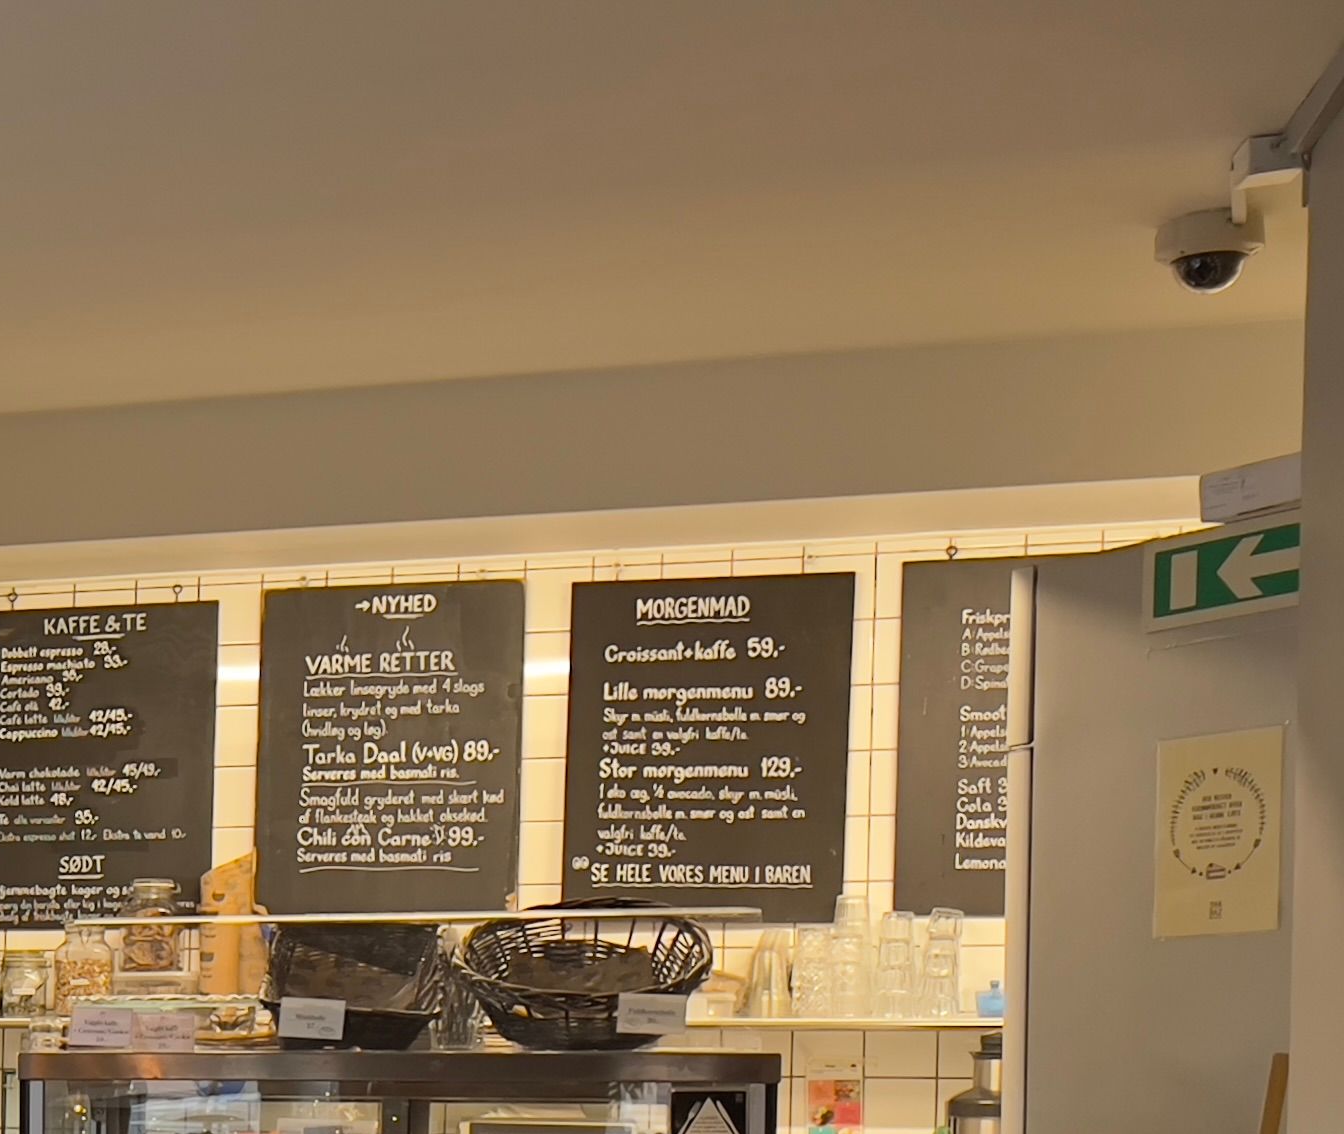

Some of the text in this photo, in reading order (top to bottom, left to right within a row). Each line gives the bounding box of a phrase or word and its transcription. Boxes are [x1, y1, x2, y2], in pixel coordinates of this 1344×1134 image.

[372, 594, 437, 614] NYHED
[636, 596, 750, 619] MORGENMAD
[44, 613, 147, 635] KAFFE & TE
[40, 648, 83, 660] espresso
[305, 651, 455, 675] VARME RETTER
[1, 661, 43, 674] Espresso
[1, 675, 54, 685] Americano
[304, 678, 485, 699] Lækker linsegryde med 4 slags
[0, 688, 39, 699] Cortado
[603, 682, 637, 701] Lille
[643, 686, 753, 706] morgenmenu
[340, 701, 381, 719] krydret
[385, 706, 397, 719] og
[400, 700, 422, 715] med
[427, 699, 459, 713] tarka
[603, 708, 628, 725] Skyr
[676, 707, 747, 722] fuldkornsbolle
[764, 712, 789, 721] smør
[792, 712, 805, 724] og
[24, 714, 47, 724] latte
[0, 728, 58, 742] Cappuccino
[348, 725, 361, 741] og
[602, 728, 617, 740] ost
[623, 727, 646, 739] samt
[652, 731, 663, 739] en
[667, 728, 699, 743] valgfri
[302, 744, 356, 765] Tarka
[364, 741, 406, 764] Daal
[29, 767, 80, 778] chokolade
[302, 766, 356, 782] Serveres
[361, 765, 386, 780] med
[390, 764, 437, 779] basmati
[599, 758, 637, 779] Stor
[643, 764, 749, 784] morgenmenu
[22, 782, 46, 792] latte
[719, 786, 745, 804] skyr
[958, 778, 991, 794] Saft
[21, 794, 44, 805] latte
[298, 788, 504, 811] Smagfuld gryderet med skært kød
[956, 797, 992, 812] Cola
[298, 809, 312, 825] af
[315, 808, 377, 825] flankesteak
[381, 813, 394, 826] og
[397, 808, 434, 823] hakket
[598, 802, 672, 819] fuldkornsbolle
[690, 810, 716, 819] smør
[719, 810, 734, 823] og
[738, 806, 754, 819] ost
[762, 806, 788, 819] samt
[792, 810, 805, 818] en
[297, 826, 336, 846] Chili
[341, 830, 371, 846] con
[378, 830, 431, 846] Carne
[597, 824, 634, 843] valgfri
[59, 856, 105, 873] SØDT
[297, 848, 451, 863] Serveres med basmati ris
[591, 864, 810, 883] SE HELE VORES MENU I BAREN
[72, 884, 102, 898] kager
[107, 886, 120, 898] og
